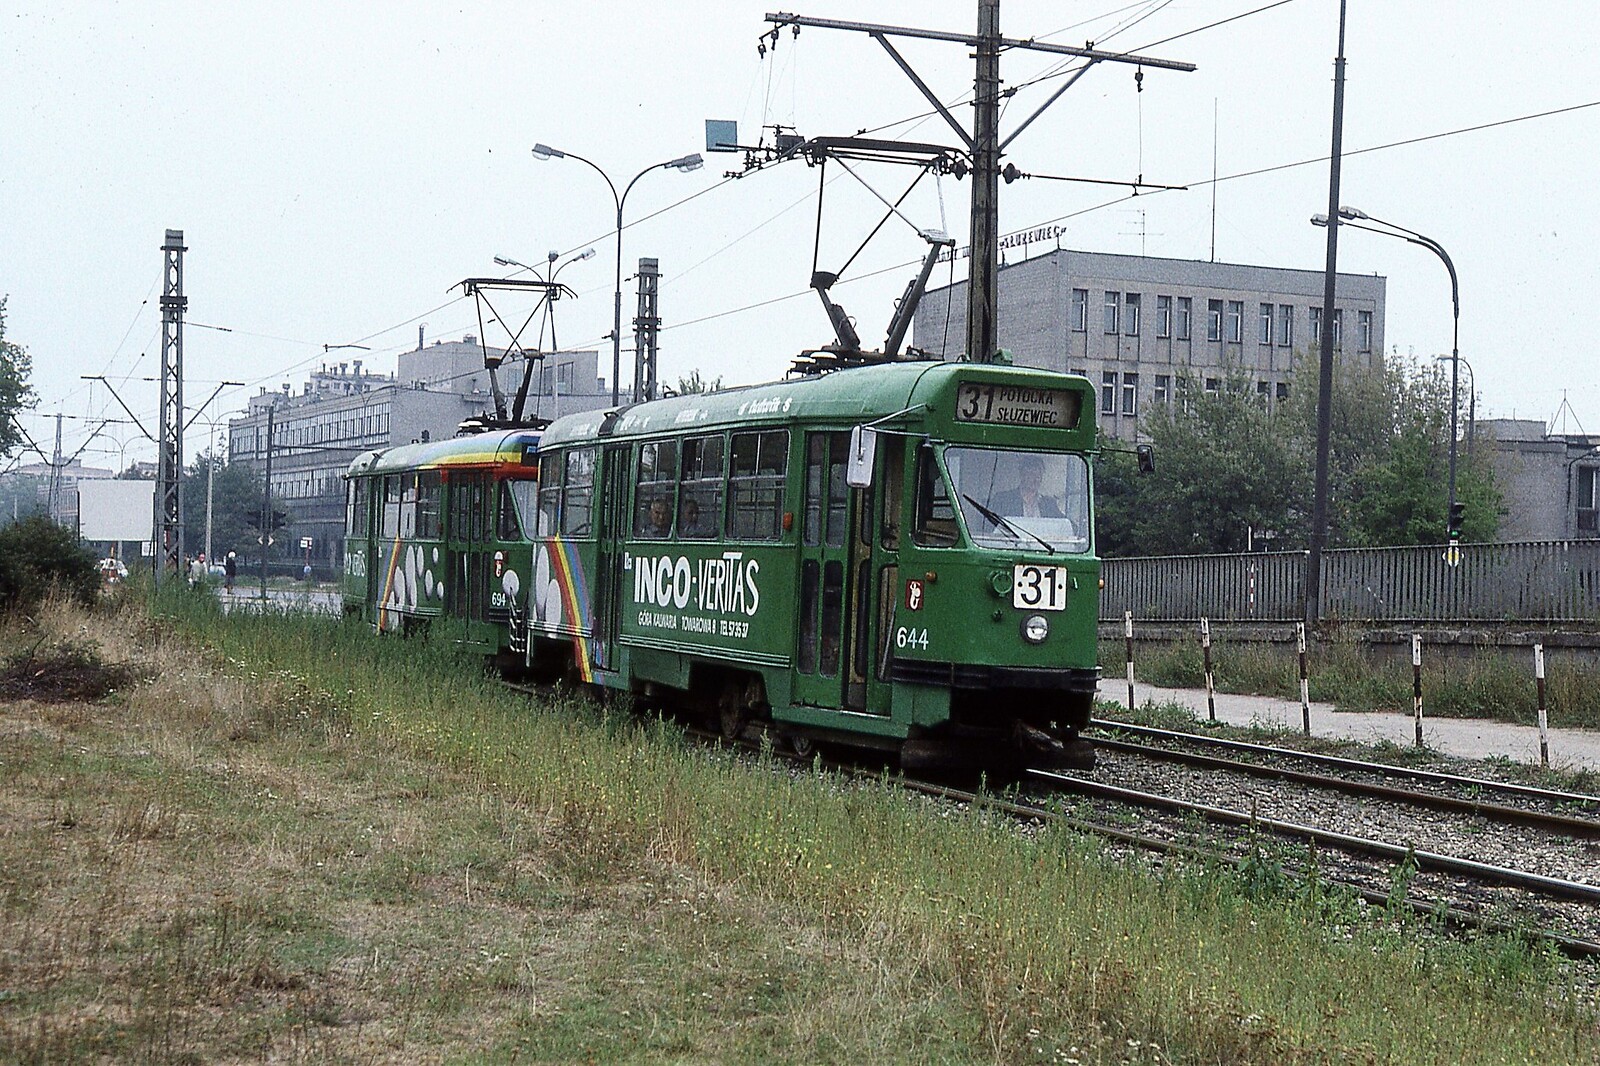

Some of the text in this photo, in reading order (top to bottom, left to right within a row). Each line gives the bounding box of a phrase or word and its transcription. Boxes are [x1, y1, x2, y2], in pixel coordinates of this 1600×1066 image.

[962, 386, 995, 420] 31
[1000, 388, 1053, 405] POTOCKA
[491, 591, 507, 607] 694
[1020, 566, 1057, 607] 31
[896, 626, 929, 651] 644
